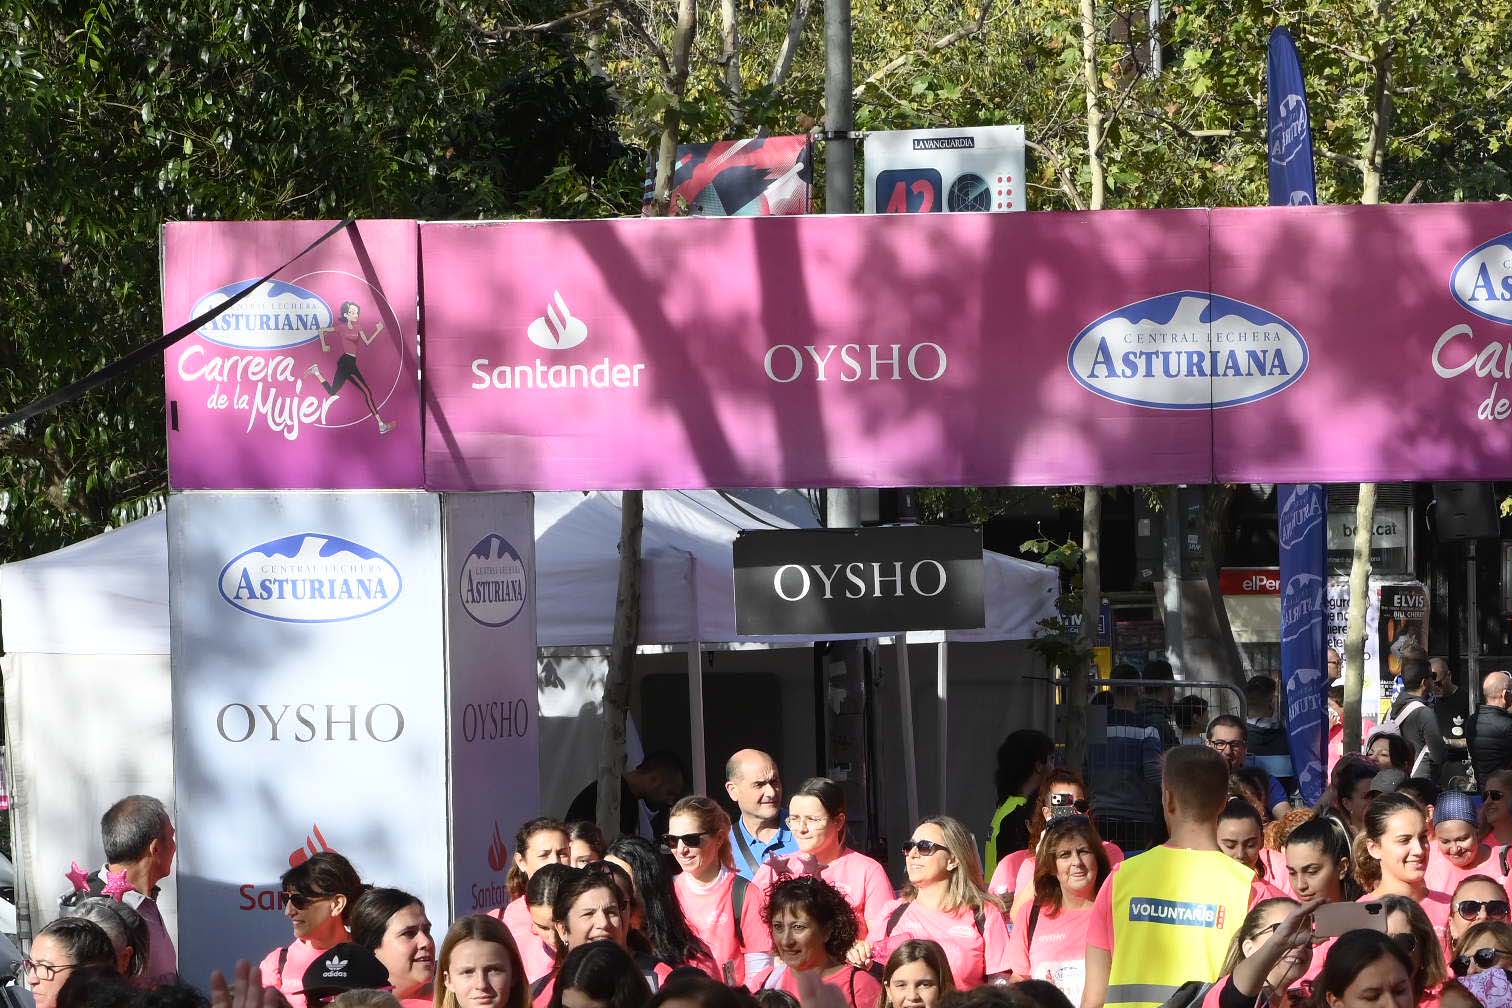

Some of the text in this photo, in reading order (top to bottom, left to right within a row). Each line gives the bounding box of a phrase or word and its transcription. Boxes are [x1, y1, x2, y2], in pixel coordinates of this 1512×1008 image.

[1124, 332, 1281, 343] CENTRAL LECHERA
[178, 345, 295, 382] Carrera
[472, 357, 644, 390] Santander
[764, 343, 947, 383] OYSHO
[1087, 343, 1291, 379] ASTURIANA
[207, 378, 340, 440] de la Mujer
[1477, 384, 1511, 420] de
[234, 567, 389, 601] ASTURIANA
[465, 573, 523, 606] ASTURIANA
[774, 560, 947, 601] OYSHO
[1242, 576, 1280, 591] elPer
[1394, 595, 1423, 607] ELVIS
[217, 703, 405, 742] OYSHO
[463, 699, 528, 743] OYSHO
